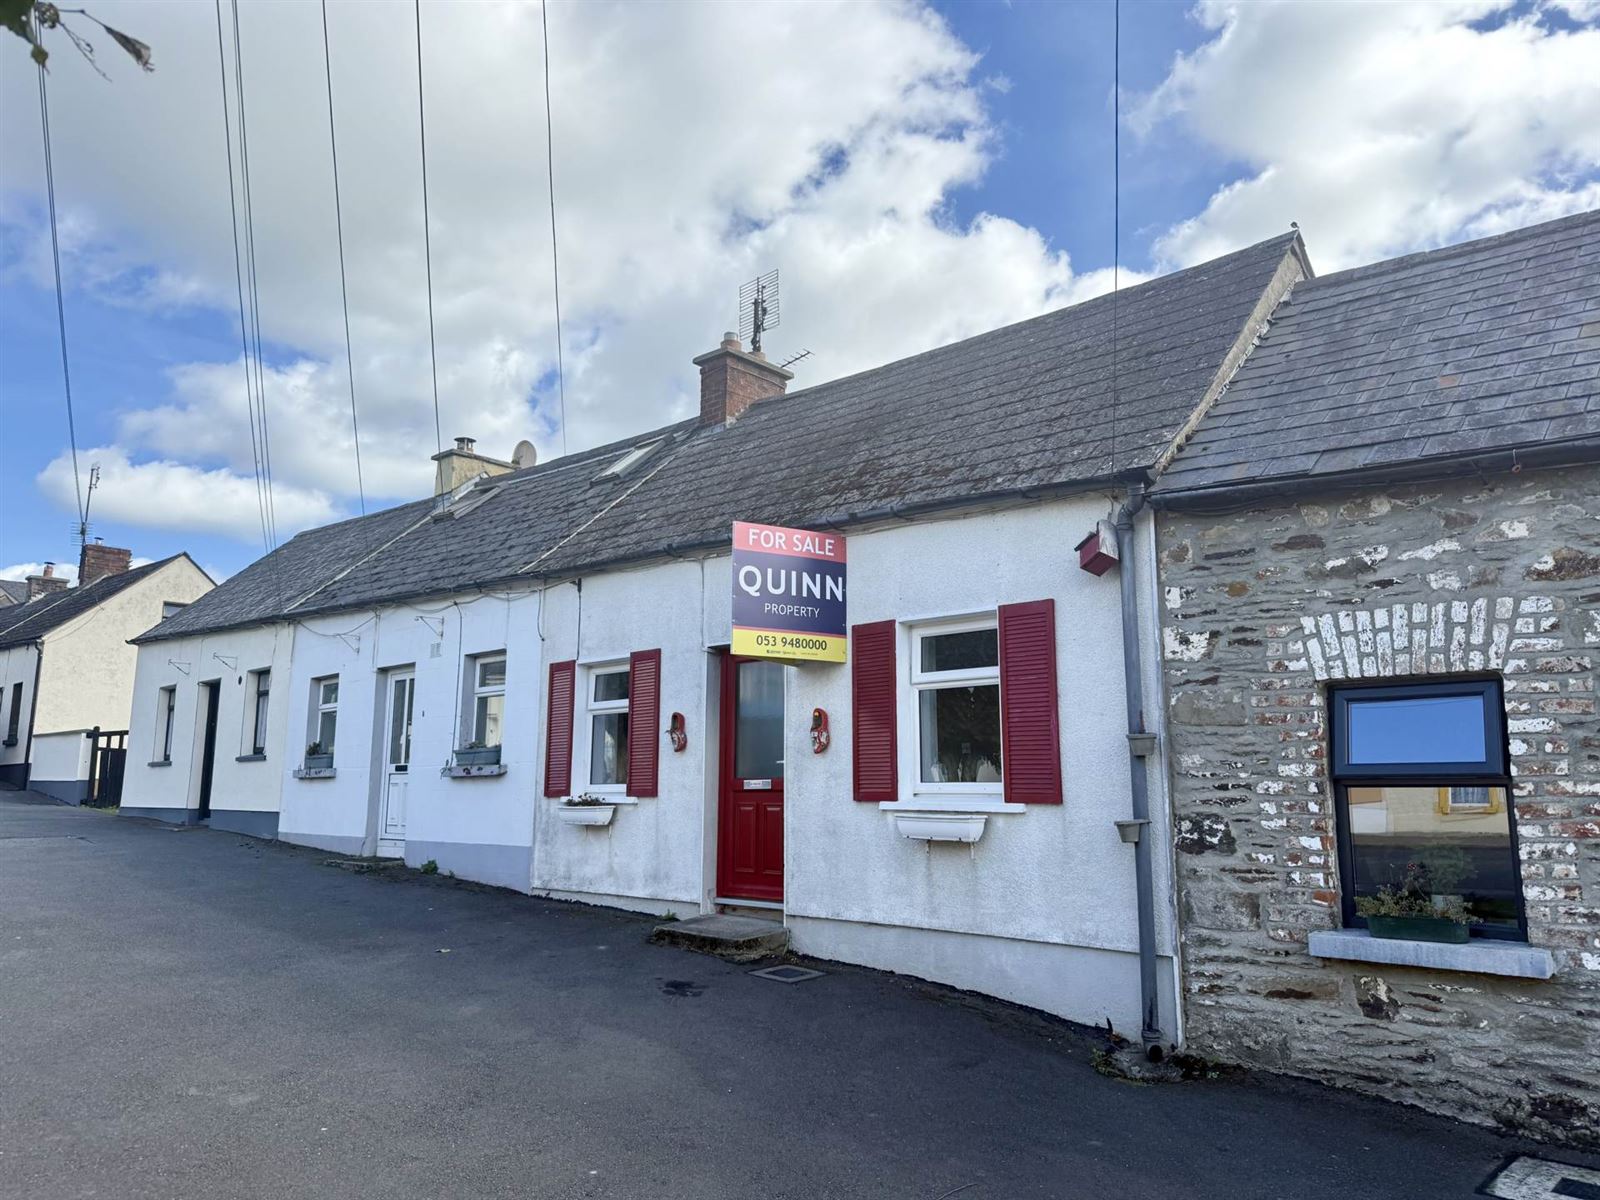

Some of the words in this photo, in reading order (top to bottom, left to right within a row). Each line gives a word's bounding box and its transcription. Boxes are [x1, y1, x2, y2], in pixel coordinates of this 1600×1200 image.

[748, 528, 787, 550] FOR
[793, 534, 835, 556] SALE
[738, 565, 843, 602] QUINN
[764, 603, 820, 618] PROPERTY
[756, 635, 777, 647] 053
[781, 636, 828, 651] 9480000
